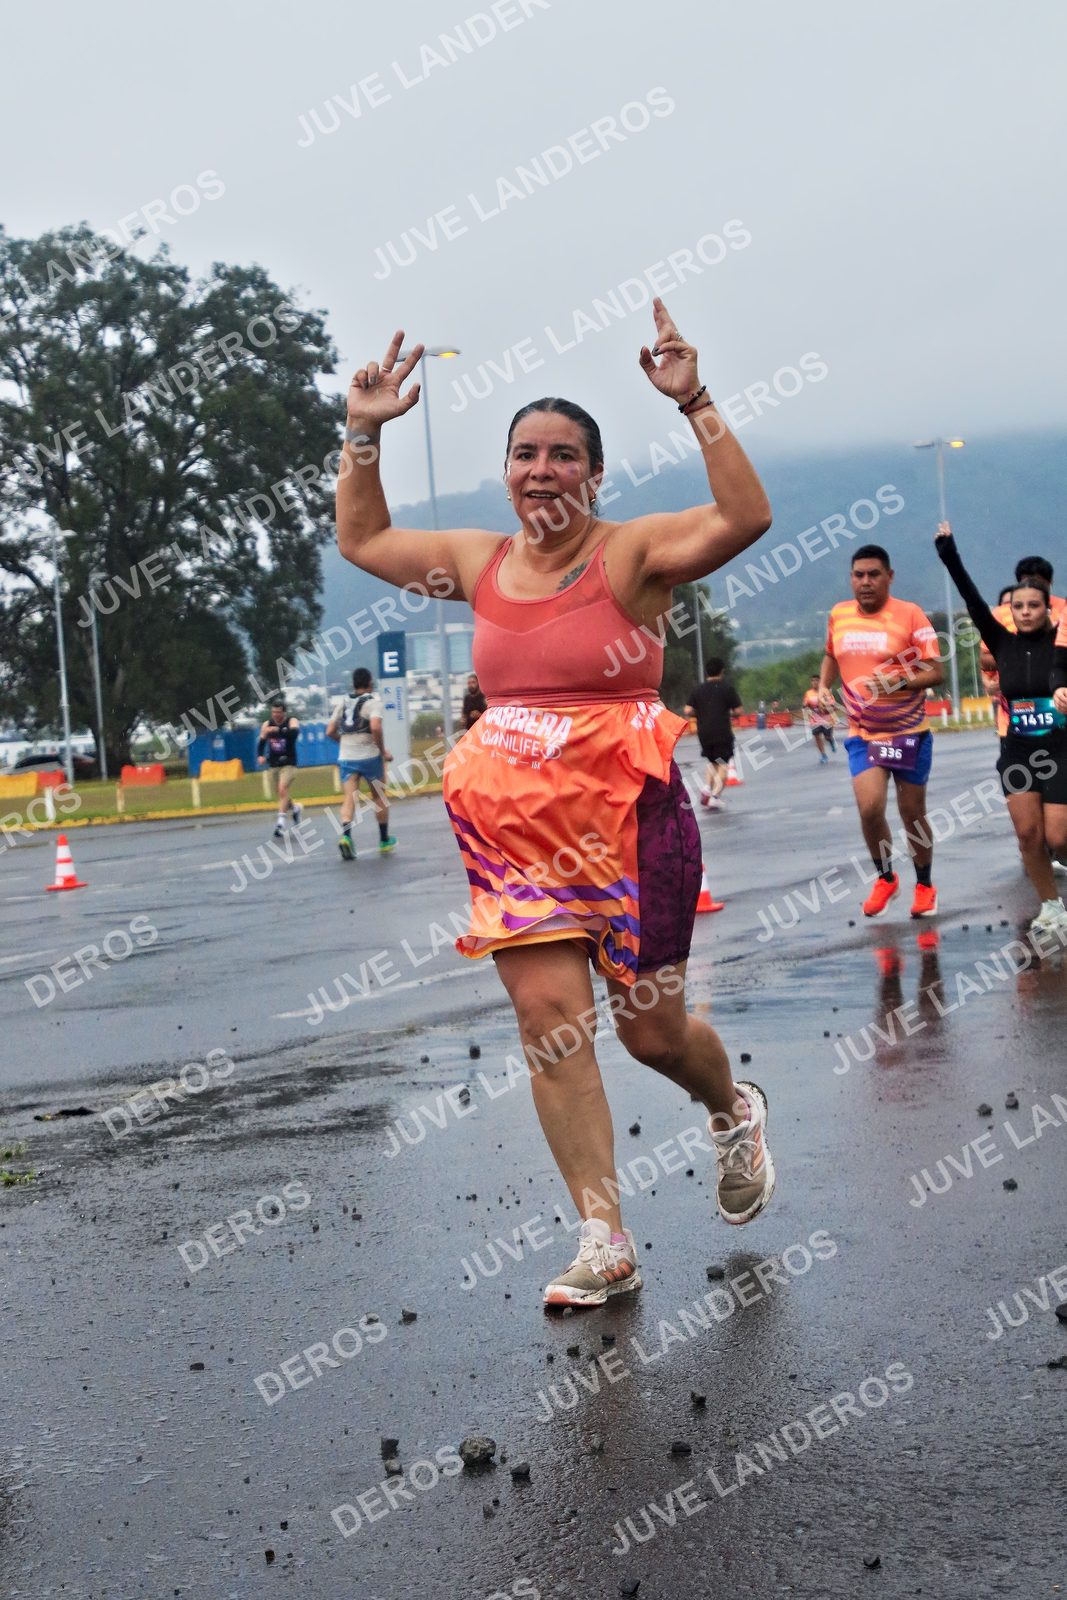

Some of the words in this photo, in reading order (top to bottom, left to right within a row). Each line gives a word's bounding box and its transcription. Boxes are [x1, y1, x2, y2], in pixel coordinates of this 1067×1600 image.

[383, 651, 400, 672] E
[1020, 712, 1054, 726] 1415
[879, 746, 903, 760] 336
